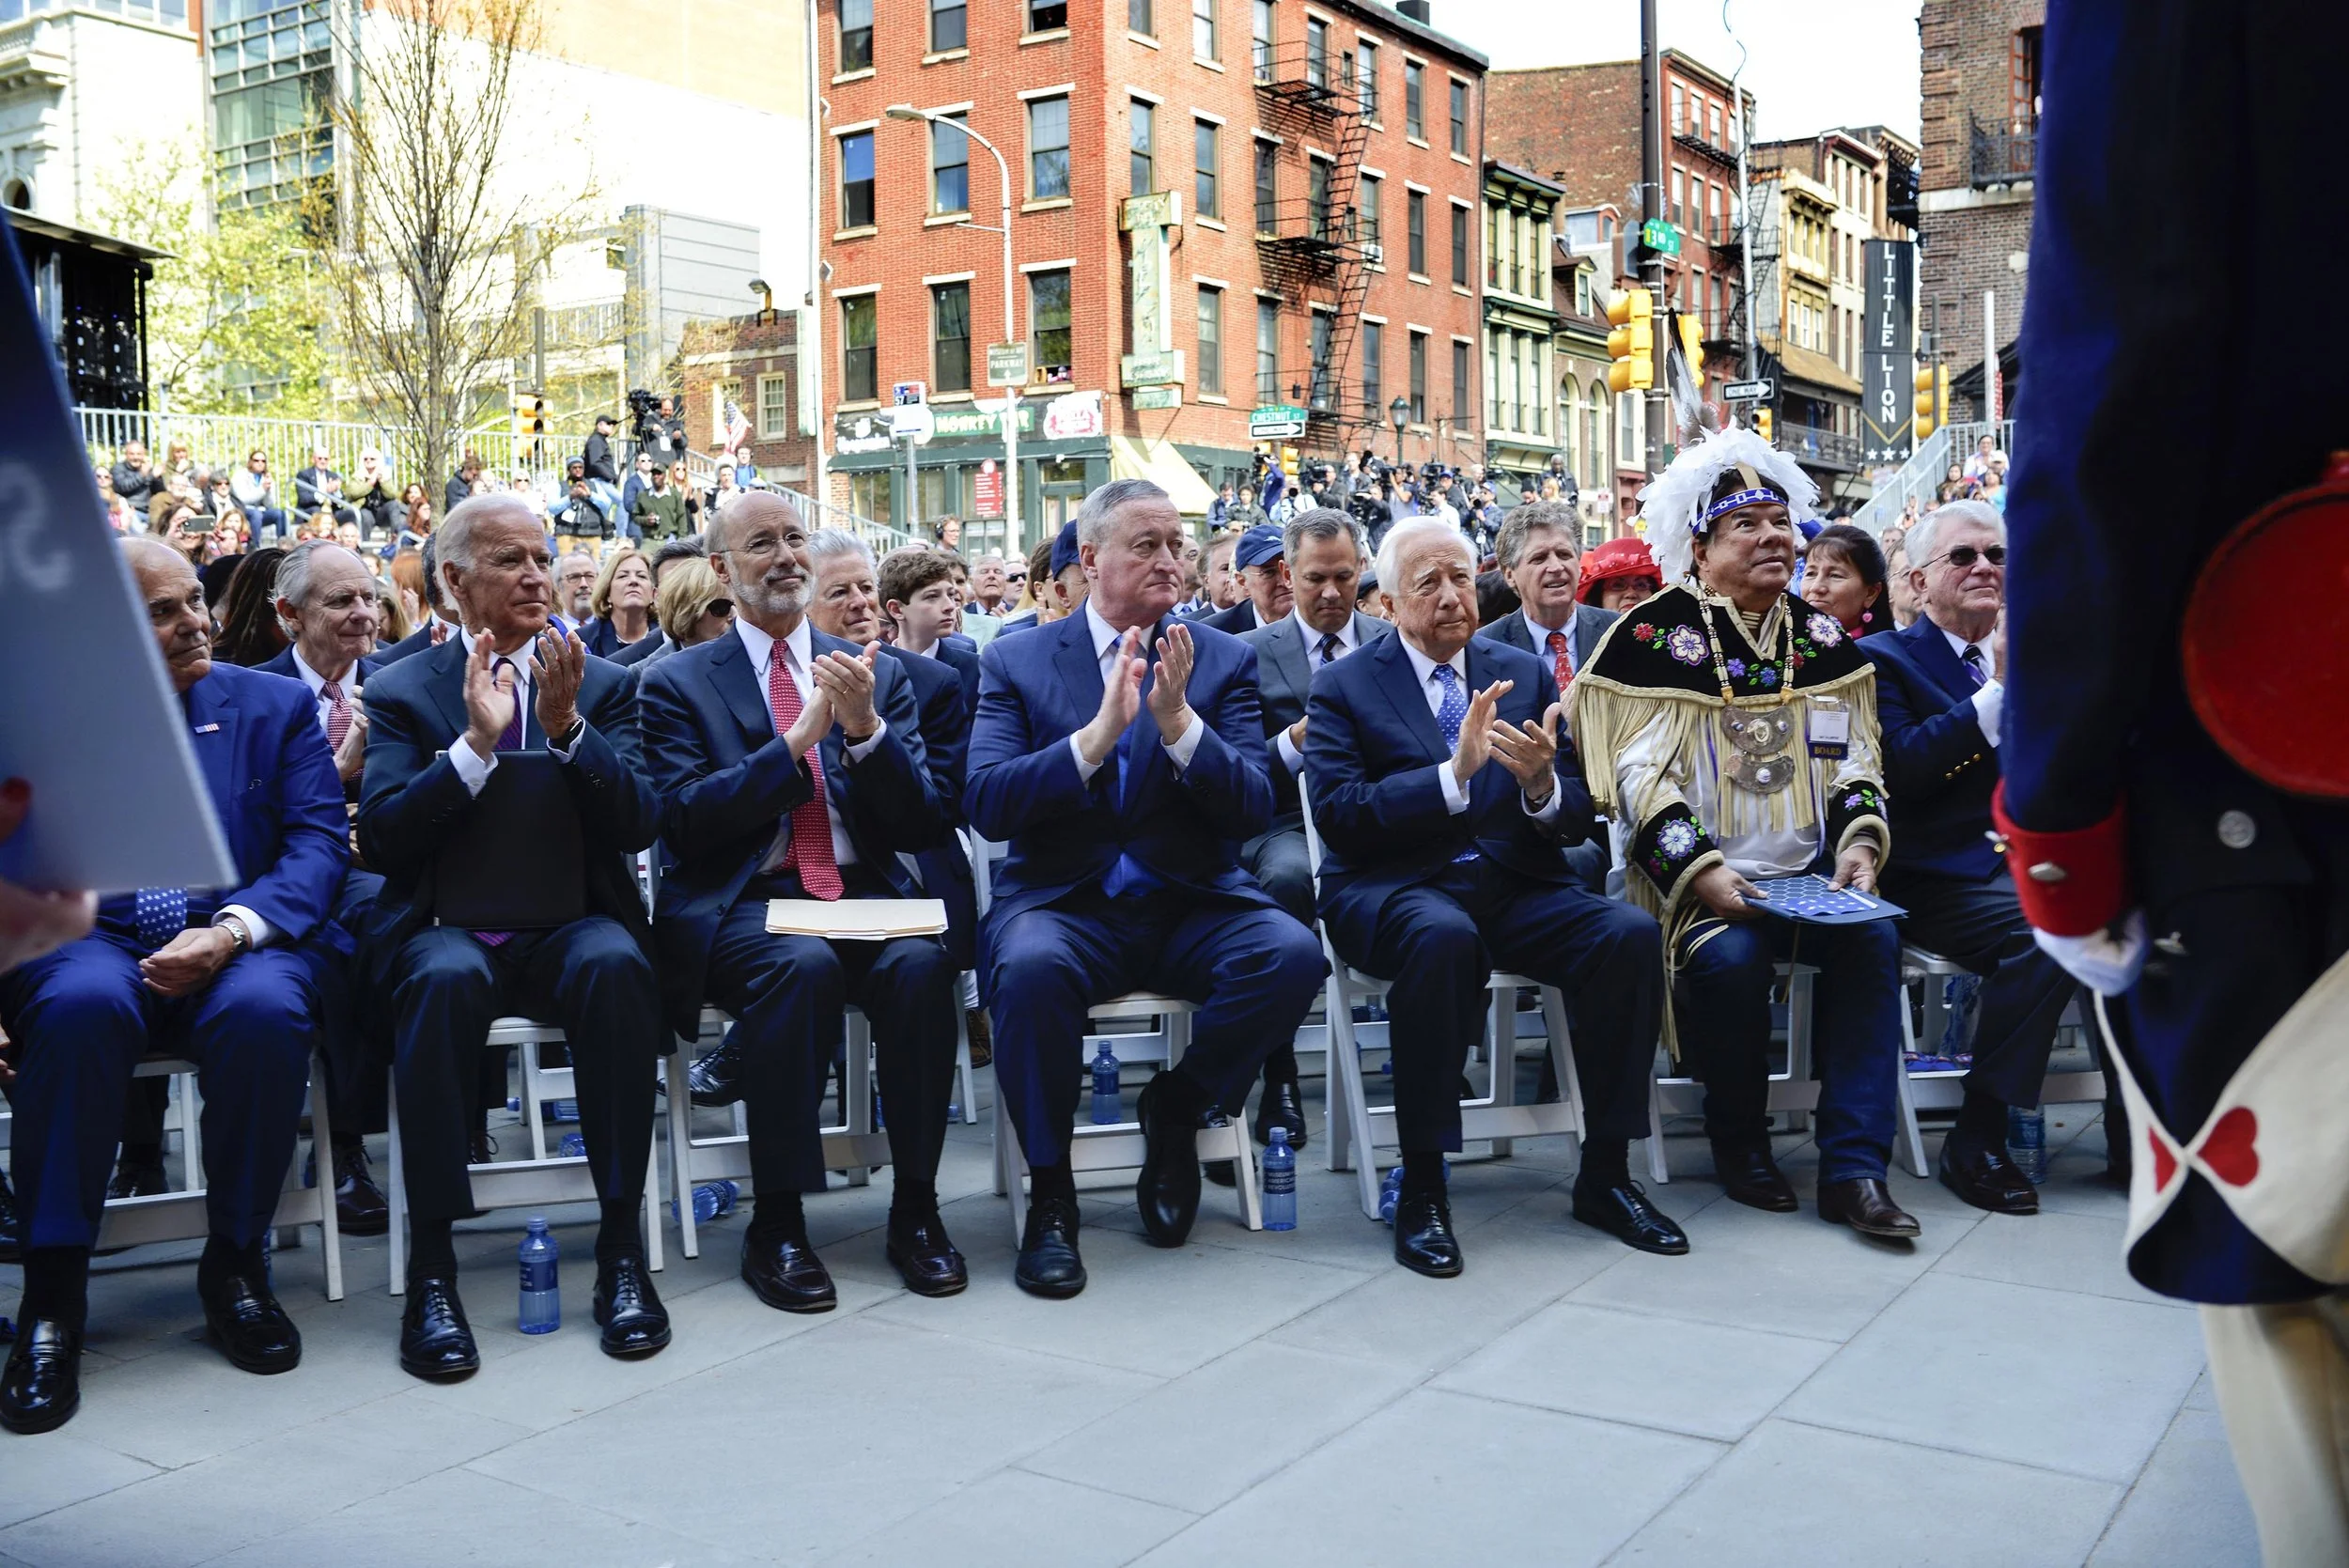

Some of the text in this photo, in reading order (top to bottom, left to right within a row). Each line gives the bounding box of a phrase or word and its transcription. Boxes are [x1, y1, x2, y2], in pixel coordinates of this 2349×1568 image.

[1881, 242, 1896, 423] LITTLE LION
[990, 359, 1025, 369] PARKWAY
[935, 413, 998, 433] MONKEY
[1252, 411, 1291, 423] CHESTNUT
[1814, 746, 1842, 755] BOARD
